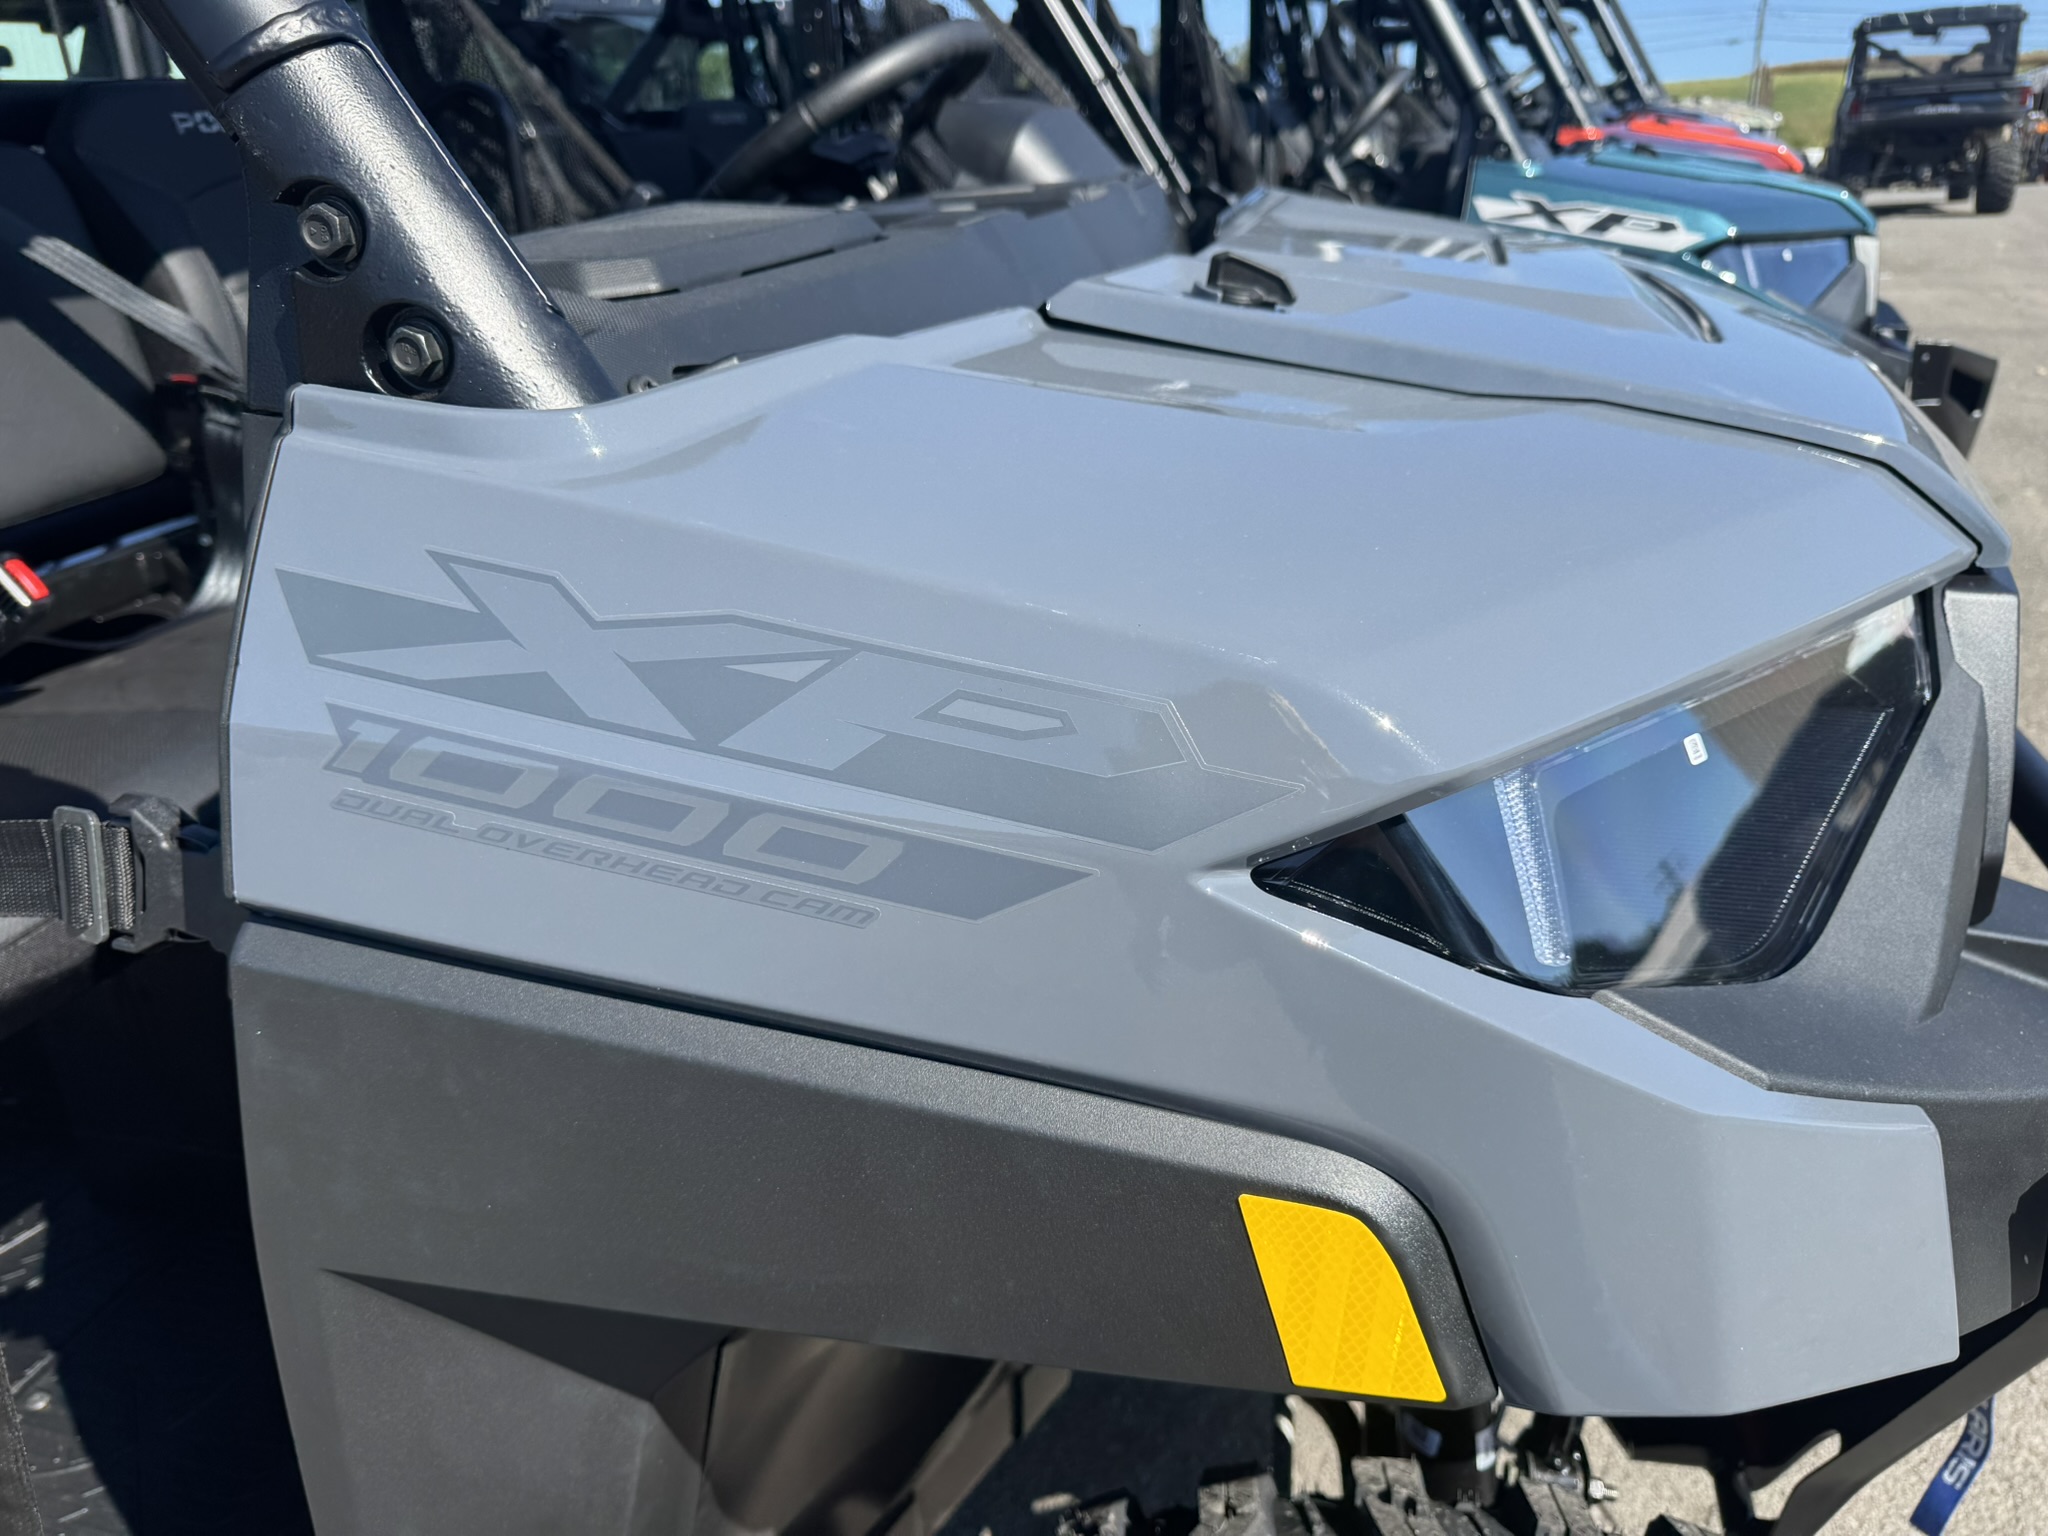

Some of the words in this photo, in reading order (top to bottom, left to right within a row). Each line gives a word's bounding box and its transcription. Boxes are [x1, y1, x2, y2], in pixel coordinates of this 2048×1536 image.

[1479, 194, 1683, 240] XP
[305, 556, 1192, 780] XP
[332, 718, 905, 885] 1000
[335, 789, 460, 834] DUAL
[475, 825, 751, 896] OVERHEAD
[758, 889, 875, 925] CAM
[1941, 1402, 1989, 1490] ARIS
